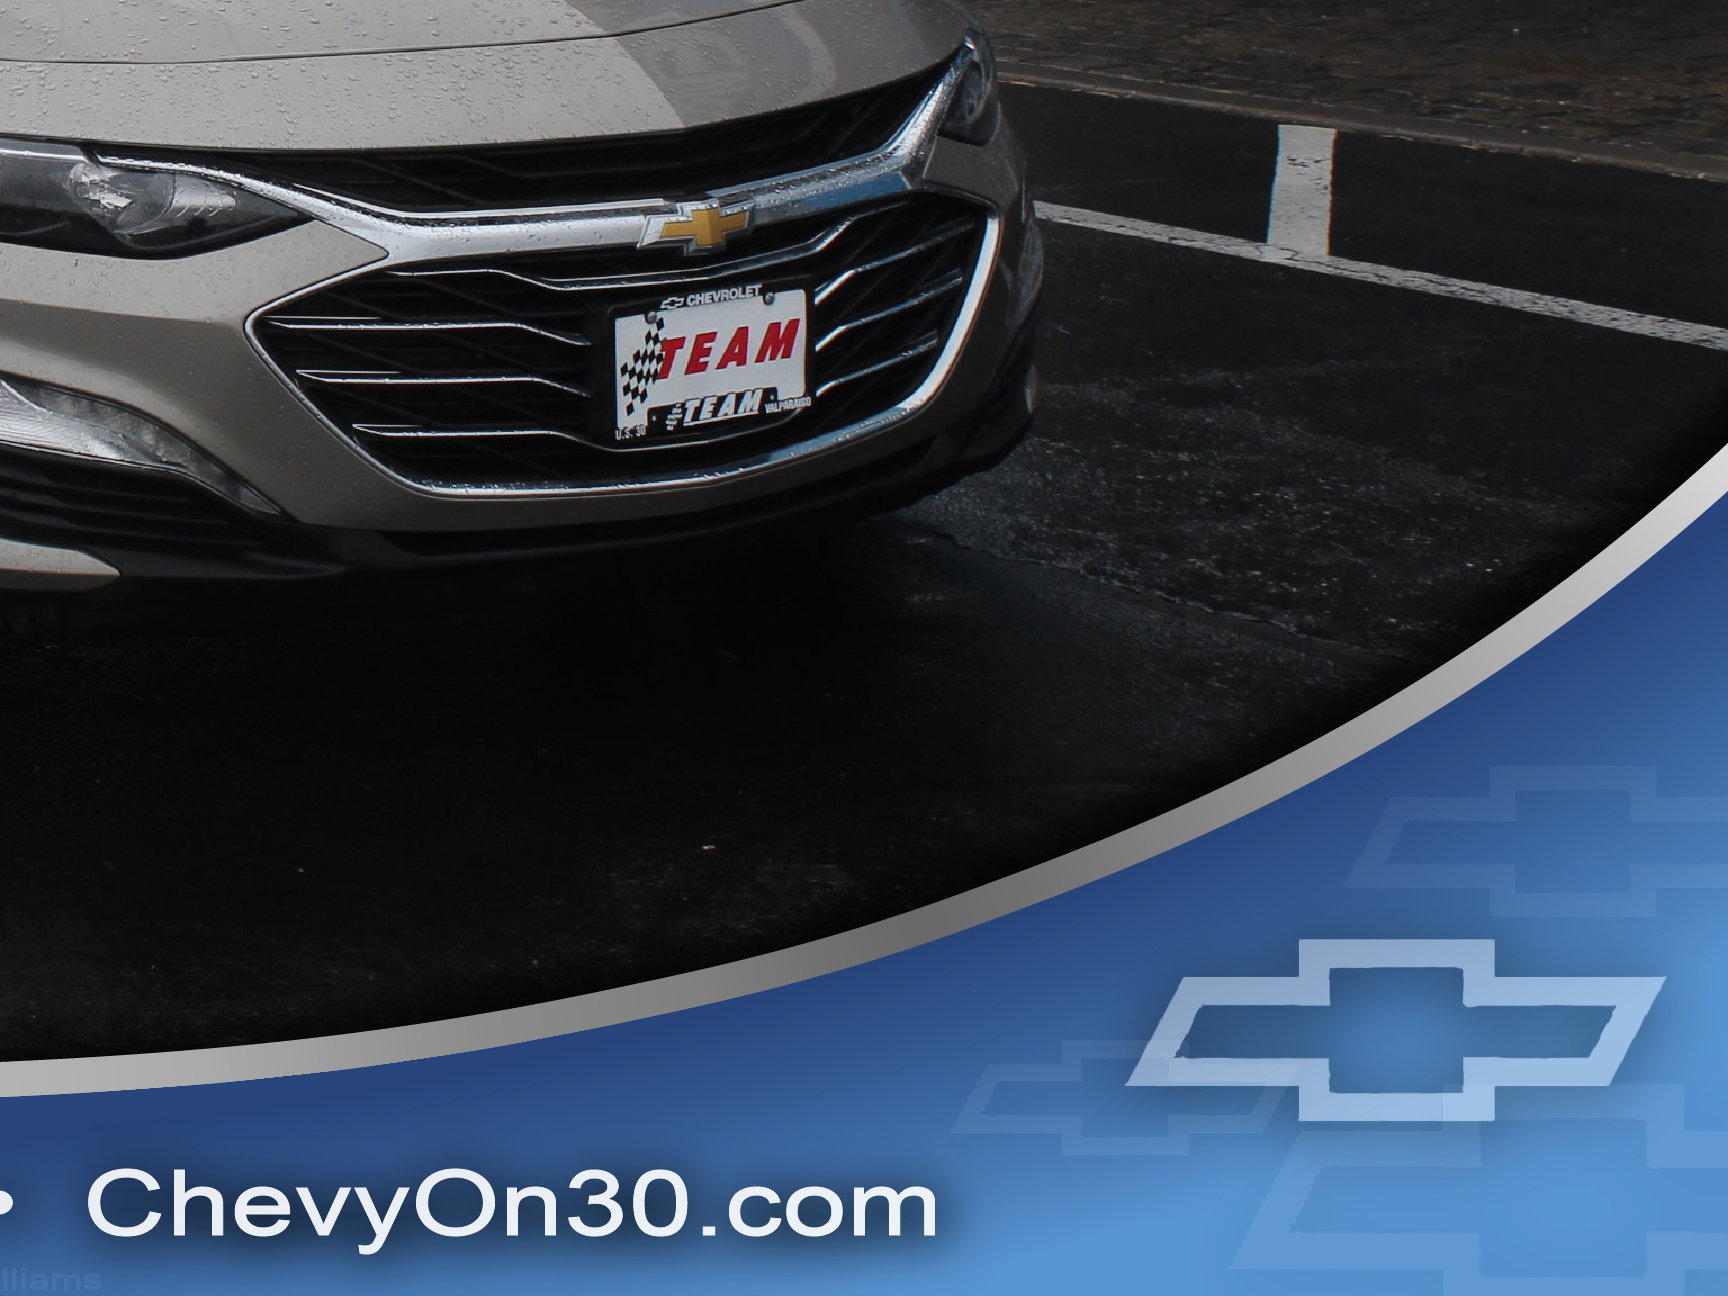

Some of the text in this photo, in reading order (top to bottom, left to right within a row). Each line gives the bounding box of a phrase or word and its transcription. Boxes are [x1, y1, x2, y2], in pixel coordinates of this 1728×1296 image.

[686, 285, 762, 307] CHEVROLET
[657, 318, 801, 380] TEAM
[683, 388, 764, 425] TEAM
[765, 396, 812, 414] VALPARAISO
